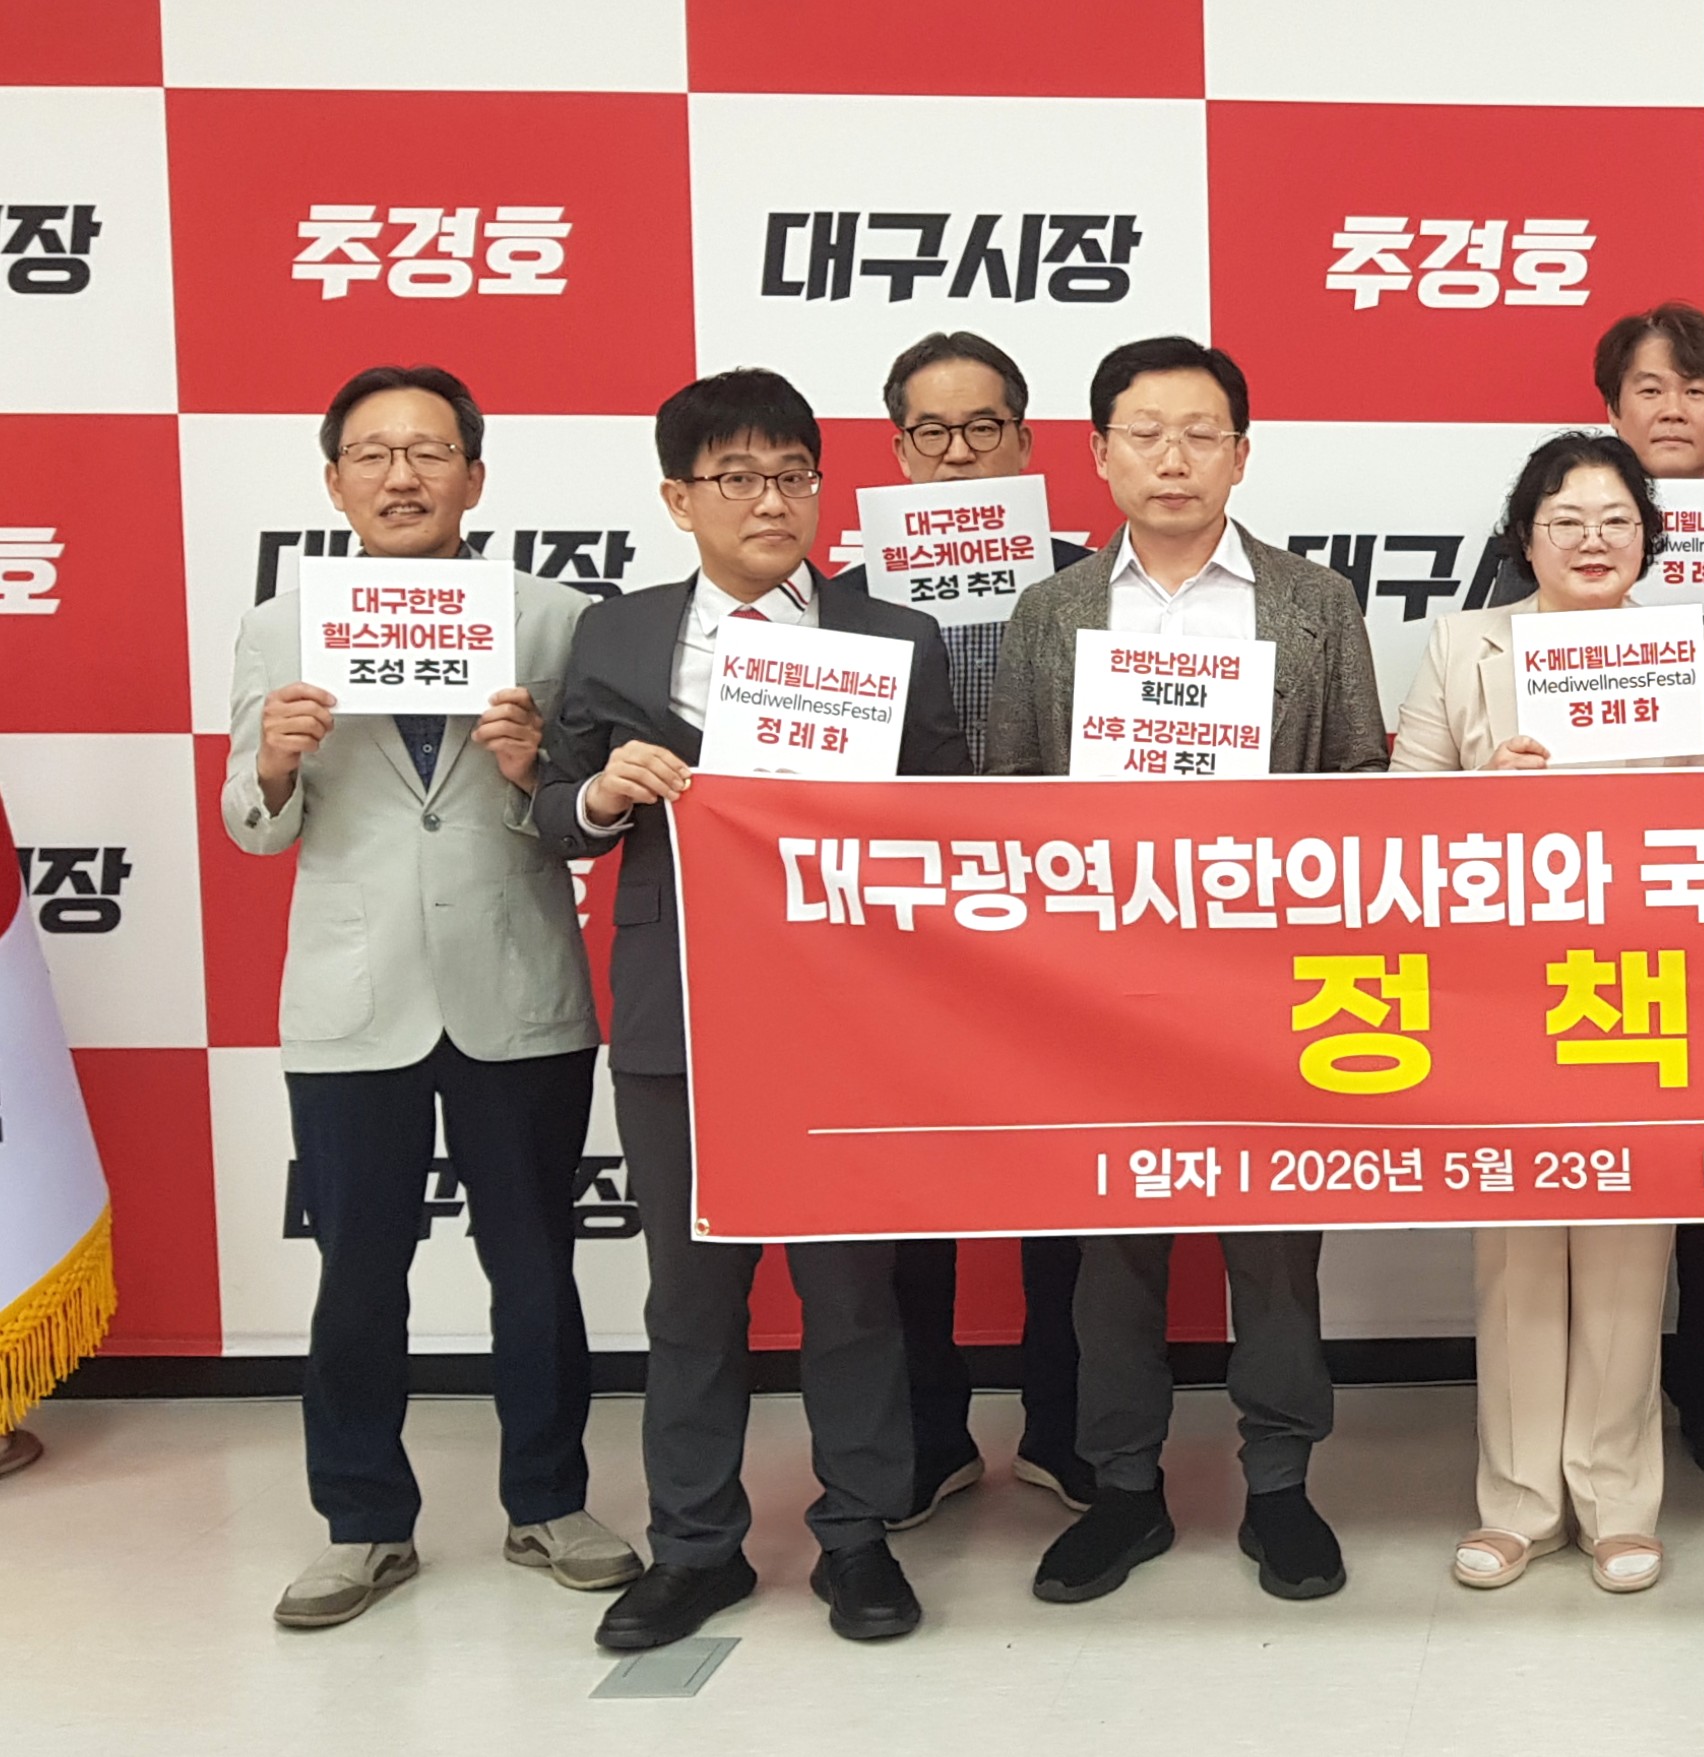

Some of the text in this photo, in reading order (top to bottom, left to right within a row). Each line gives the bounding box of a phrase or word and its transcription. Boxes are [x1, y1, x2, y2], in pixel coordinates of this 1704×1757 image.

[292, 204, 572, 300] 추경호
[760, 211, 1143, 304] 대구시장
[1325, 216, 1597, 310] 추경호
[904, 504, 1006, 537] 대구한방
[881, 534, 1035, 573] 헬스케어타운
[352, 587, 466, 615] 대구한방
[909, 569, 1017, 603] 조성 추진
[322, 622, 494, 651] 헬스케어타운
[349, 658, 469, 686] 조성 추진
[1110, 648, 1240, 680] 한방난임사업
[1525, 639, 1696, 673] K-메디웰니스페스타
[723, 655, 897, 701] K-메디웰니스페스타
[1141, 680, 1208, 708] 확대와
[1527, 668, 1696, 696] (MediwellnessFesta)
[720, 685, 892, 722] (MediwellnessFesta)
[1082, 715, 1260, 750] 산후 건강관리지원
[1124, 748, 1216, 776] 사업 추진
[778, 830, 1613, 932] 대구광역시한의사회와
[1129, 1147, 1222, 1199] 일자
[1270, 1148, 1423, 1192] 2026년
[1445, 1147, 1514, 1192] 5월
[1534, 1147, 1632, 1192] 23일
